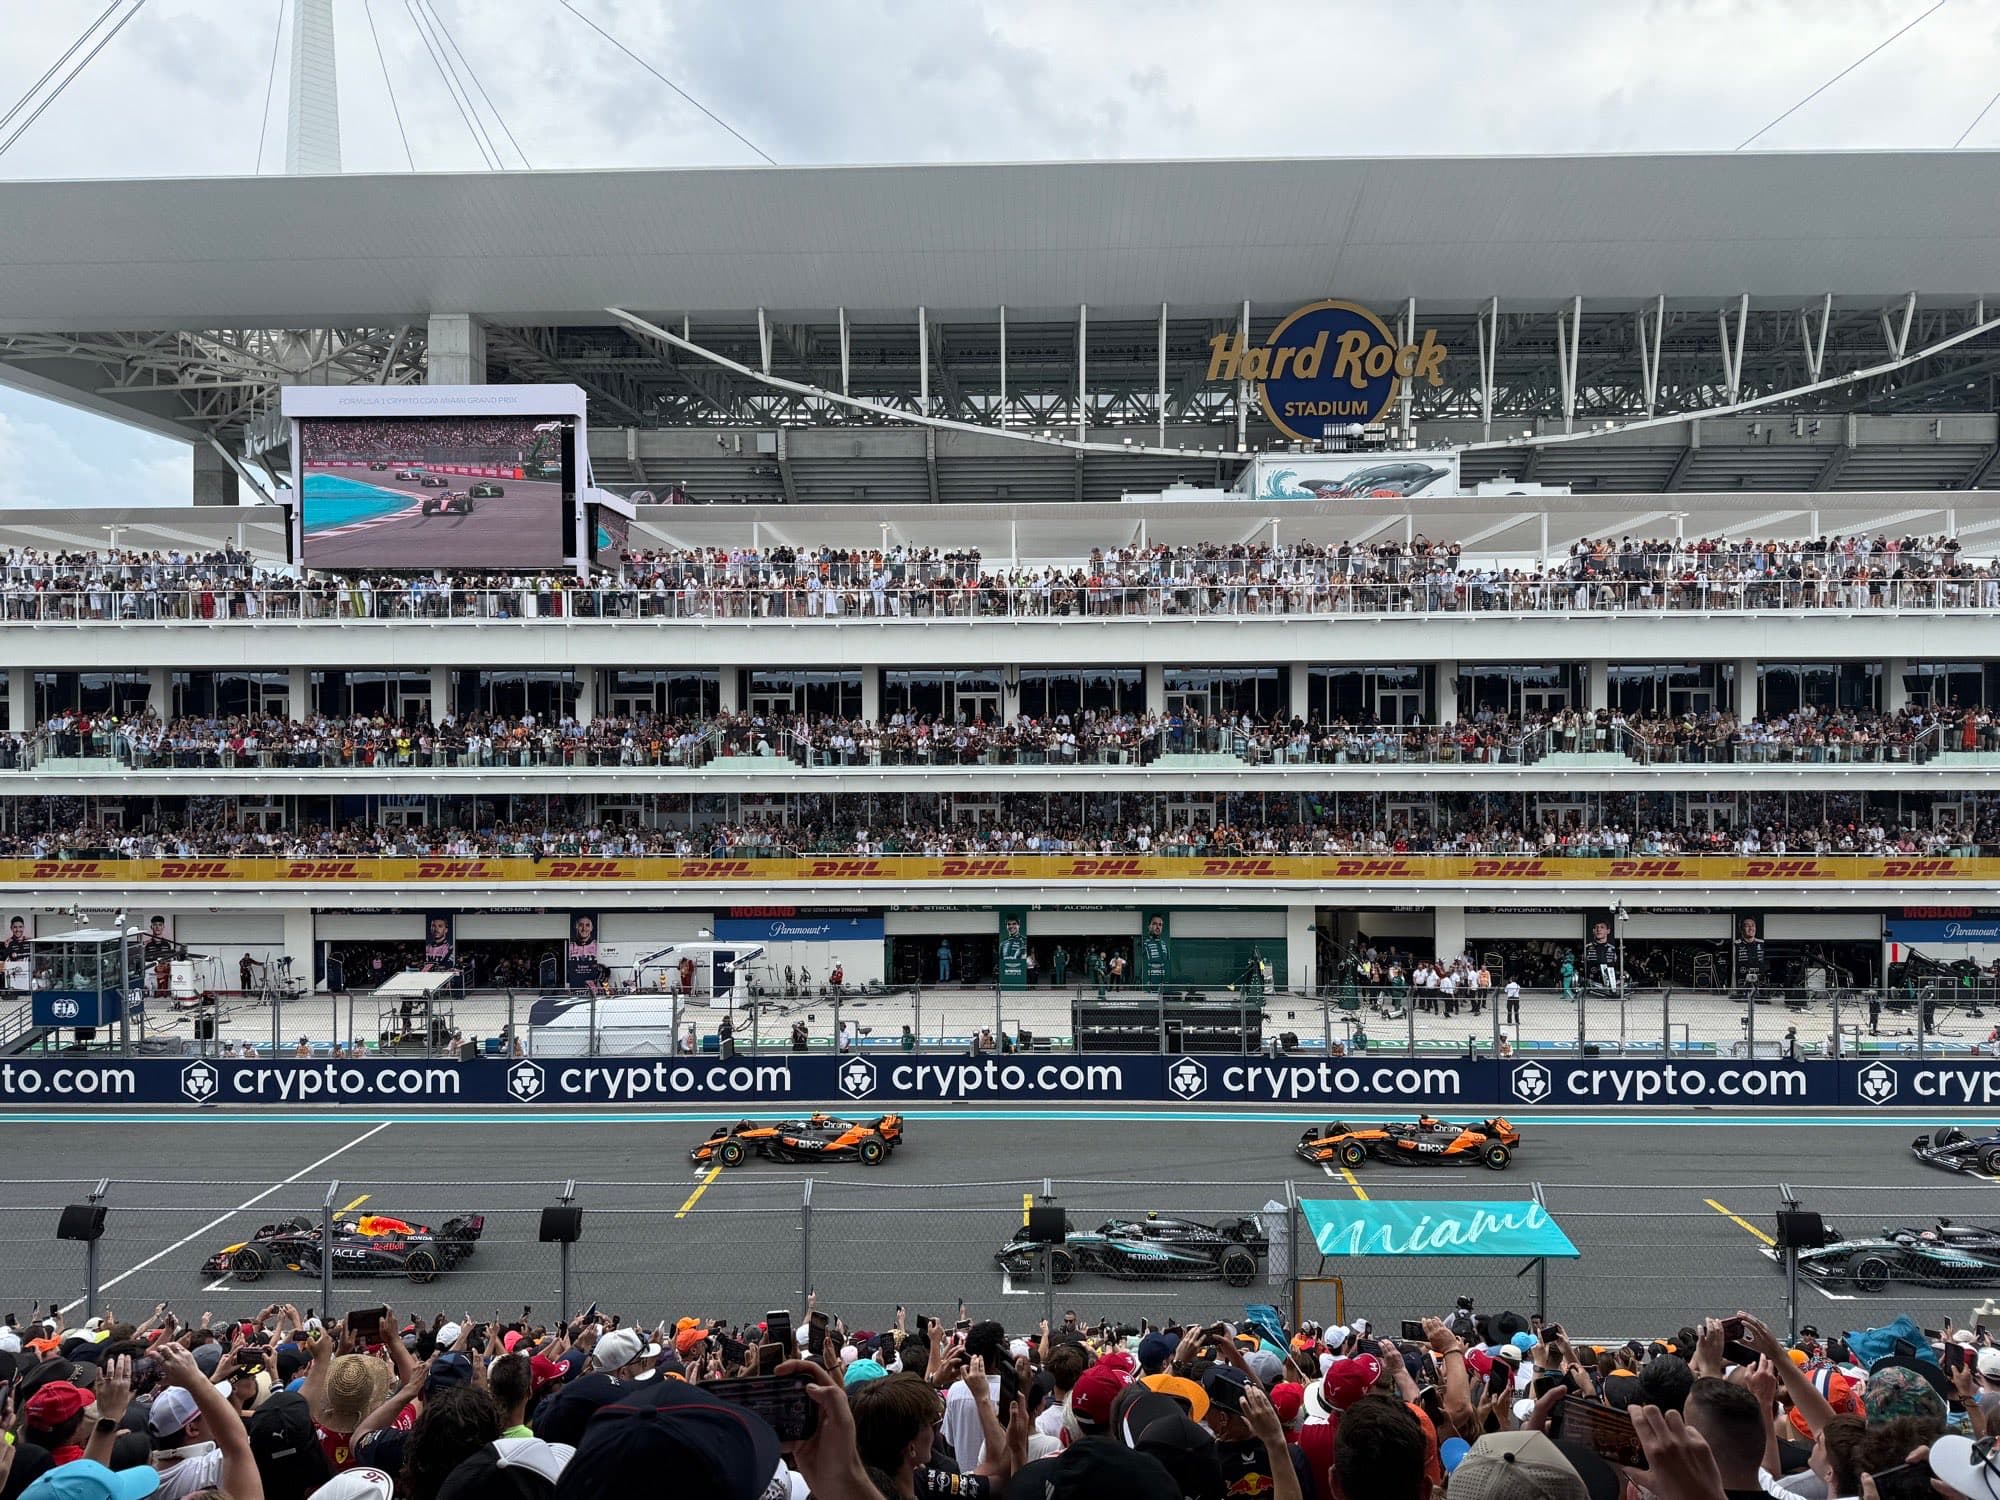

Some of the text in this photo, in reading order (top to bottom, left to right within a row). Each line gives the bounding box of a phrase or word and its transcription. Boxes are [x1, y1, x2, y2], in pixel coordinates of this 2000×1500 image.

[1206, 329, 1447, 388] Hard Rock
[1284, 401, 1368, 416] STADIUM
[32, 863, 103, 878] DHL
[160, 863, 231, 878] DHL
[288, 863, 359, 878] DHL
[417, 863, 490, 878] DHL
[549, 862, 623, 877] DHL
[681, 862, 753, 877] DHL
[812, 861, 883, 876] DHL
[941, 861, 1013, 876] DHL
[1071, 860, 1144, 875] DHL
[1202, 861, 1276, 875] DHL
[1336, 861, 1411, 876] DHL
[1472, 861, 1548, 876] DHL
[1609, 861, 1685, 876] DHL
[1745, 862, 1821, 876] DHL
[1882, 861, 1959, 876] DHL
[730, 906, 797, 917] MOBLAND
[1903, 907, 1974, 918] MOBLAND
[769, 921, 830, 937] Paramount+
[233, 1064, 460, 1100] crypto.com
[560, 1062, 791, 1099] crypto.com
[892, 1060, 1122, 1097] crypto.com
[1222, 1062, 1460, 1099] crypto.com
[1567, 1064, 1807, 1101] crypto.com
[823, 1120, 852, 1129] Chrome
[799, 1139, 823, 1149] OKX
[1418, 1143, 1444, 1152] OKX
[1314, 1200, 1550, 1257] Miami
[1128, 1252, 1169, 1261] PETRONAS
[1940, 1260, 1984, 1269] PETRONAS
